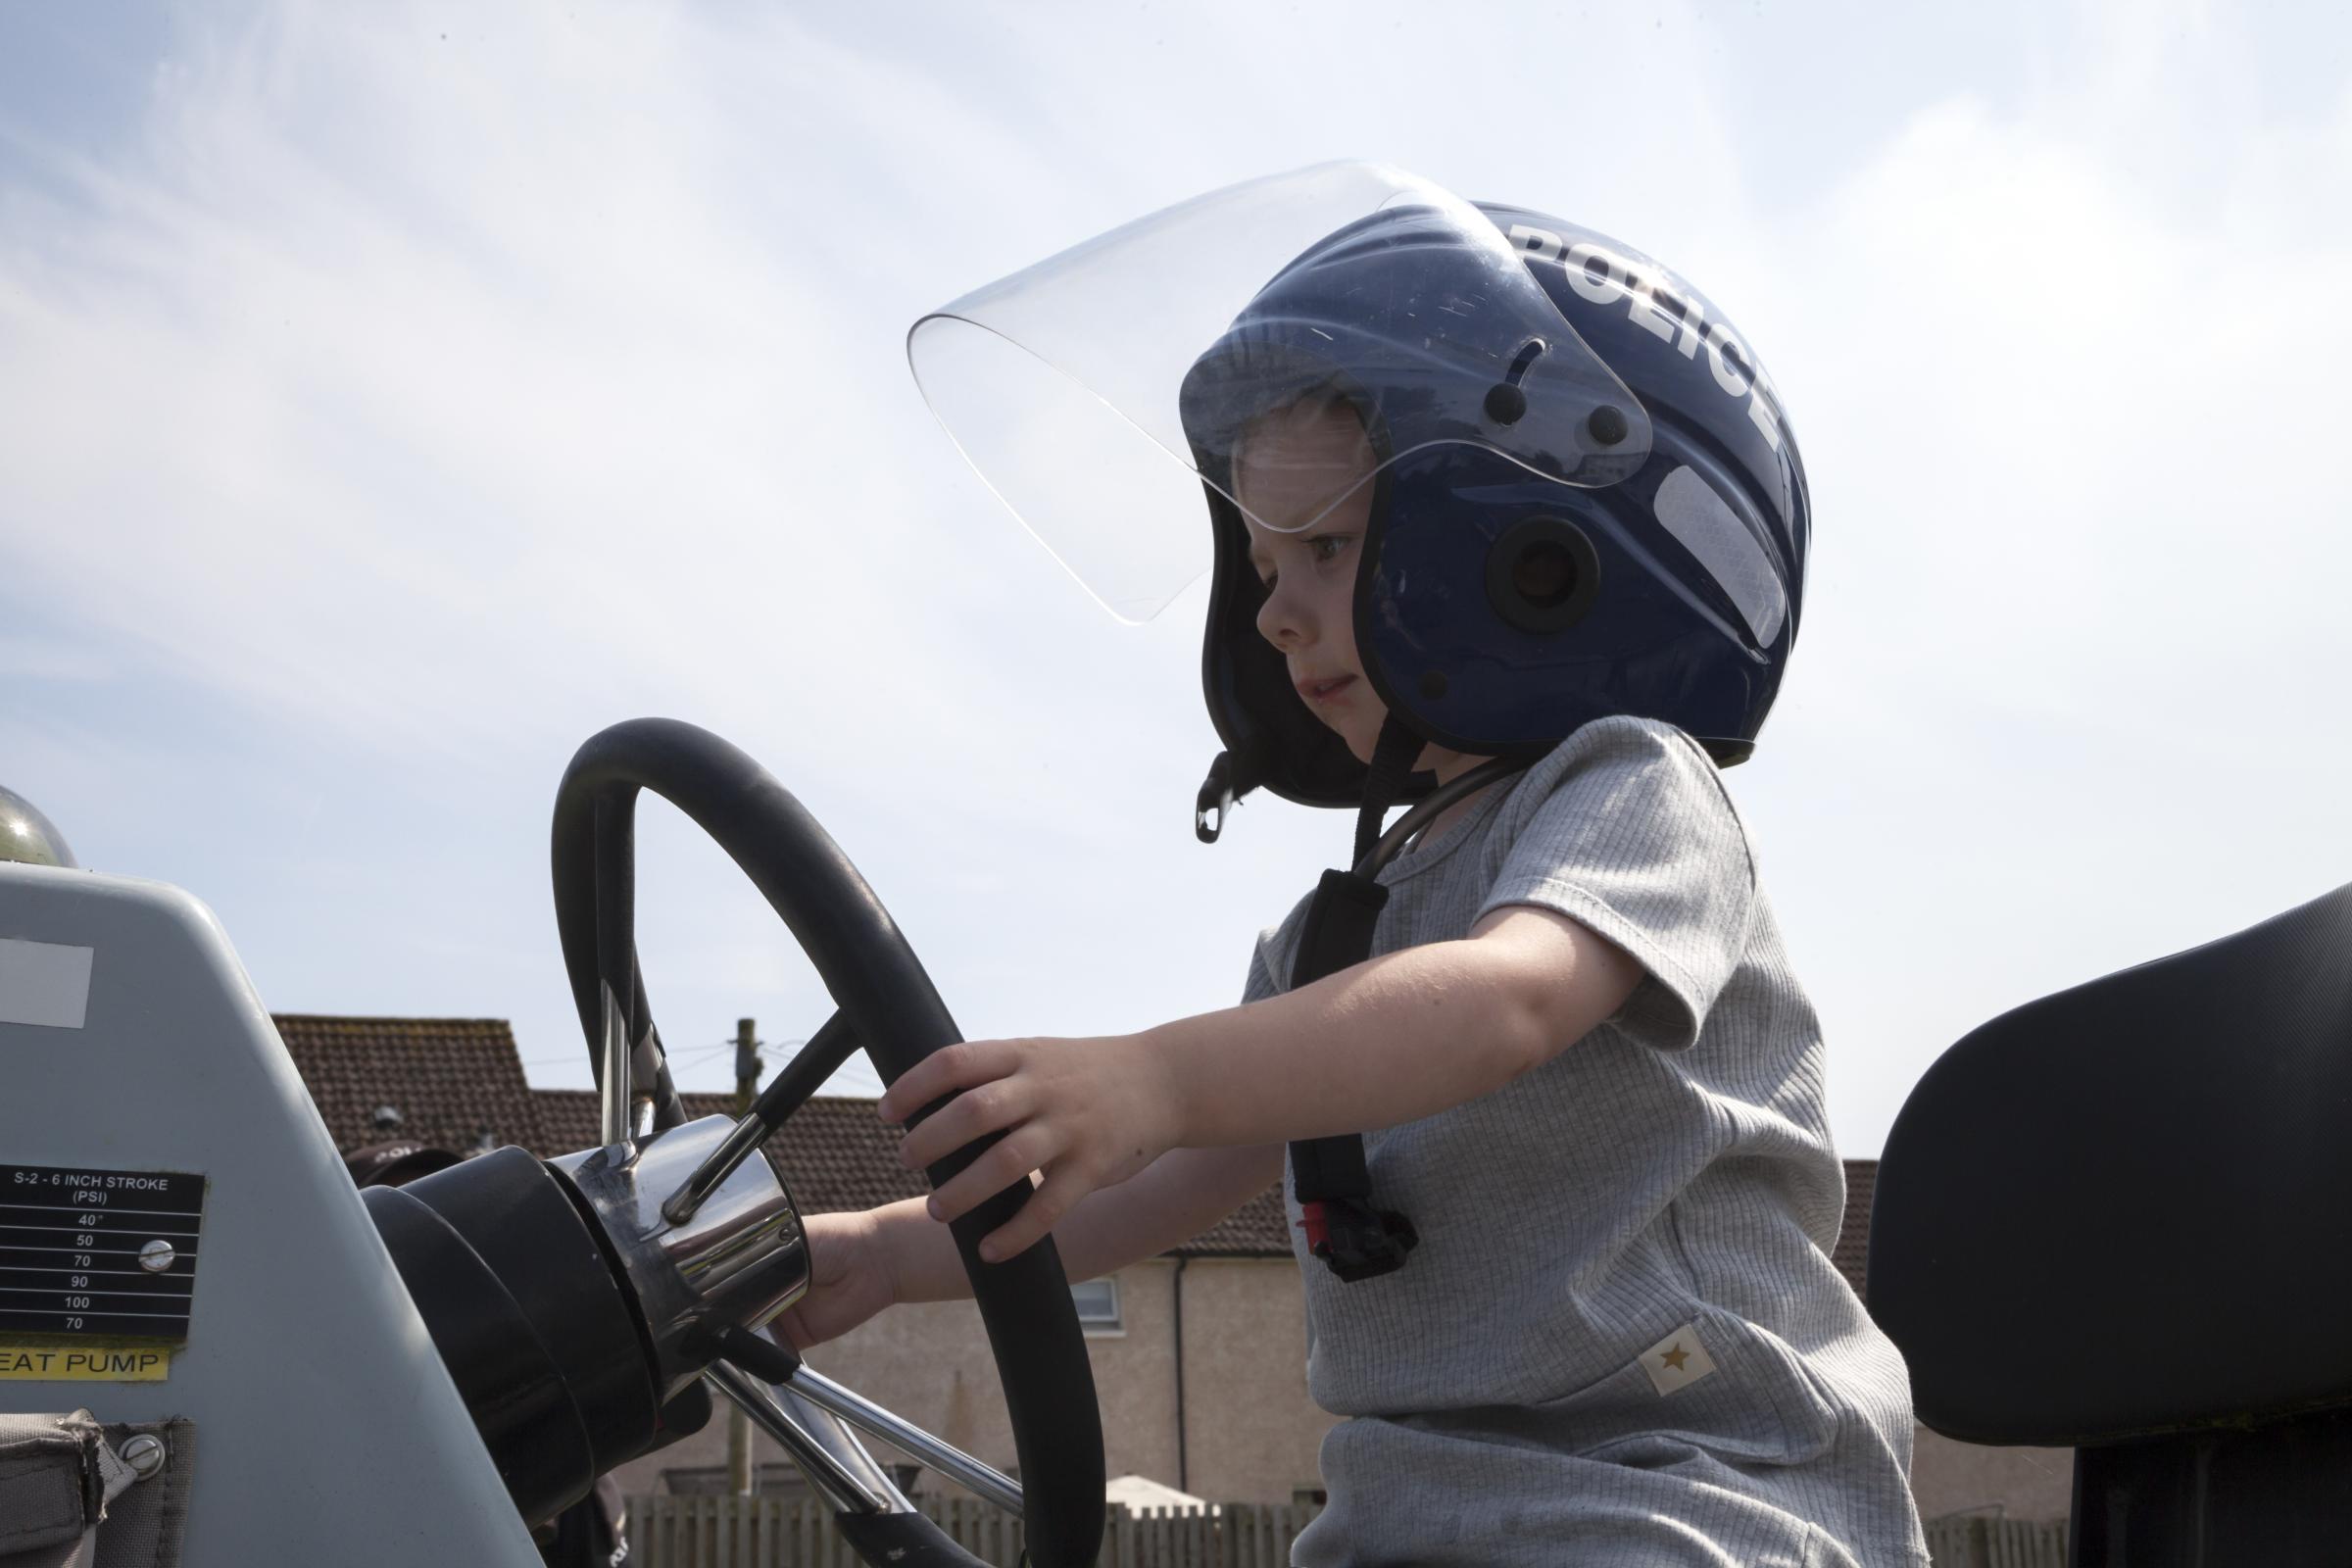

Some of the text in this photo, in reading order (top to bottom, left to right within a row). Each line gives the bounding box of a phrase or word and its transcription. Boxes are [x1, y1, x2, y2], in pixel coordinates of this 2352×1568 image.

[1508, 223, 1788, 453] POLICE
[15, 1172, 37, 1185] S-2
[52, 1174, 60, 1185] 6
[65, 1175, 101, 1188] INCH
[106, 1177, 169, 1191] STROKE
[73, 1191, 108, 1205] (PSI)
[76, 1235, 93, 1247] 50
[74, 1255, 91, 1267] 70
[71, 1276, 88, 1288] 90
[65, 1297, 90, 1309] 100
[66, 1317, 83, 1330] 70
[66, 1354, 159, 1373] PUMP
